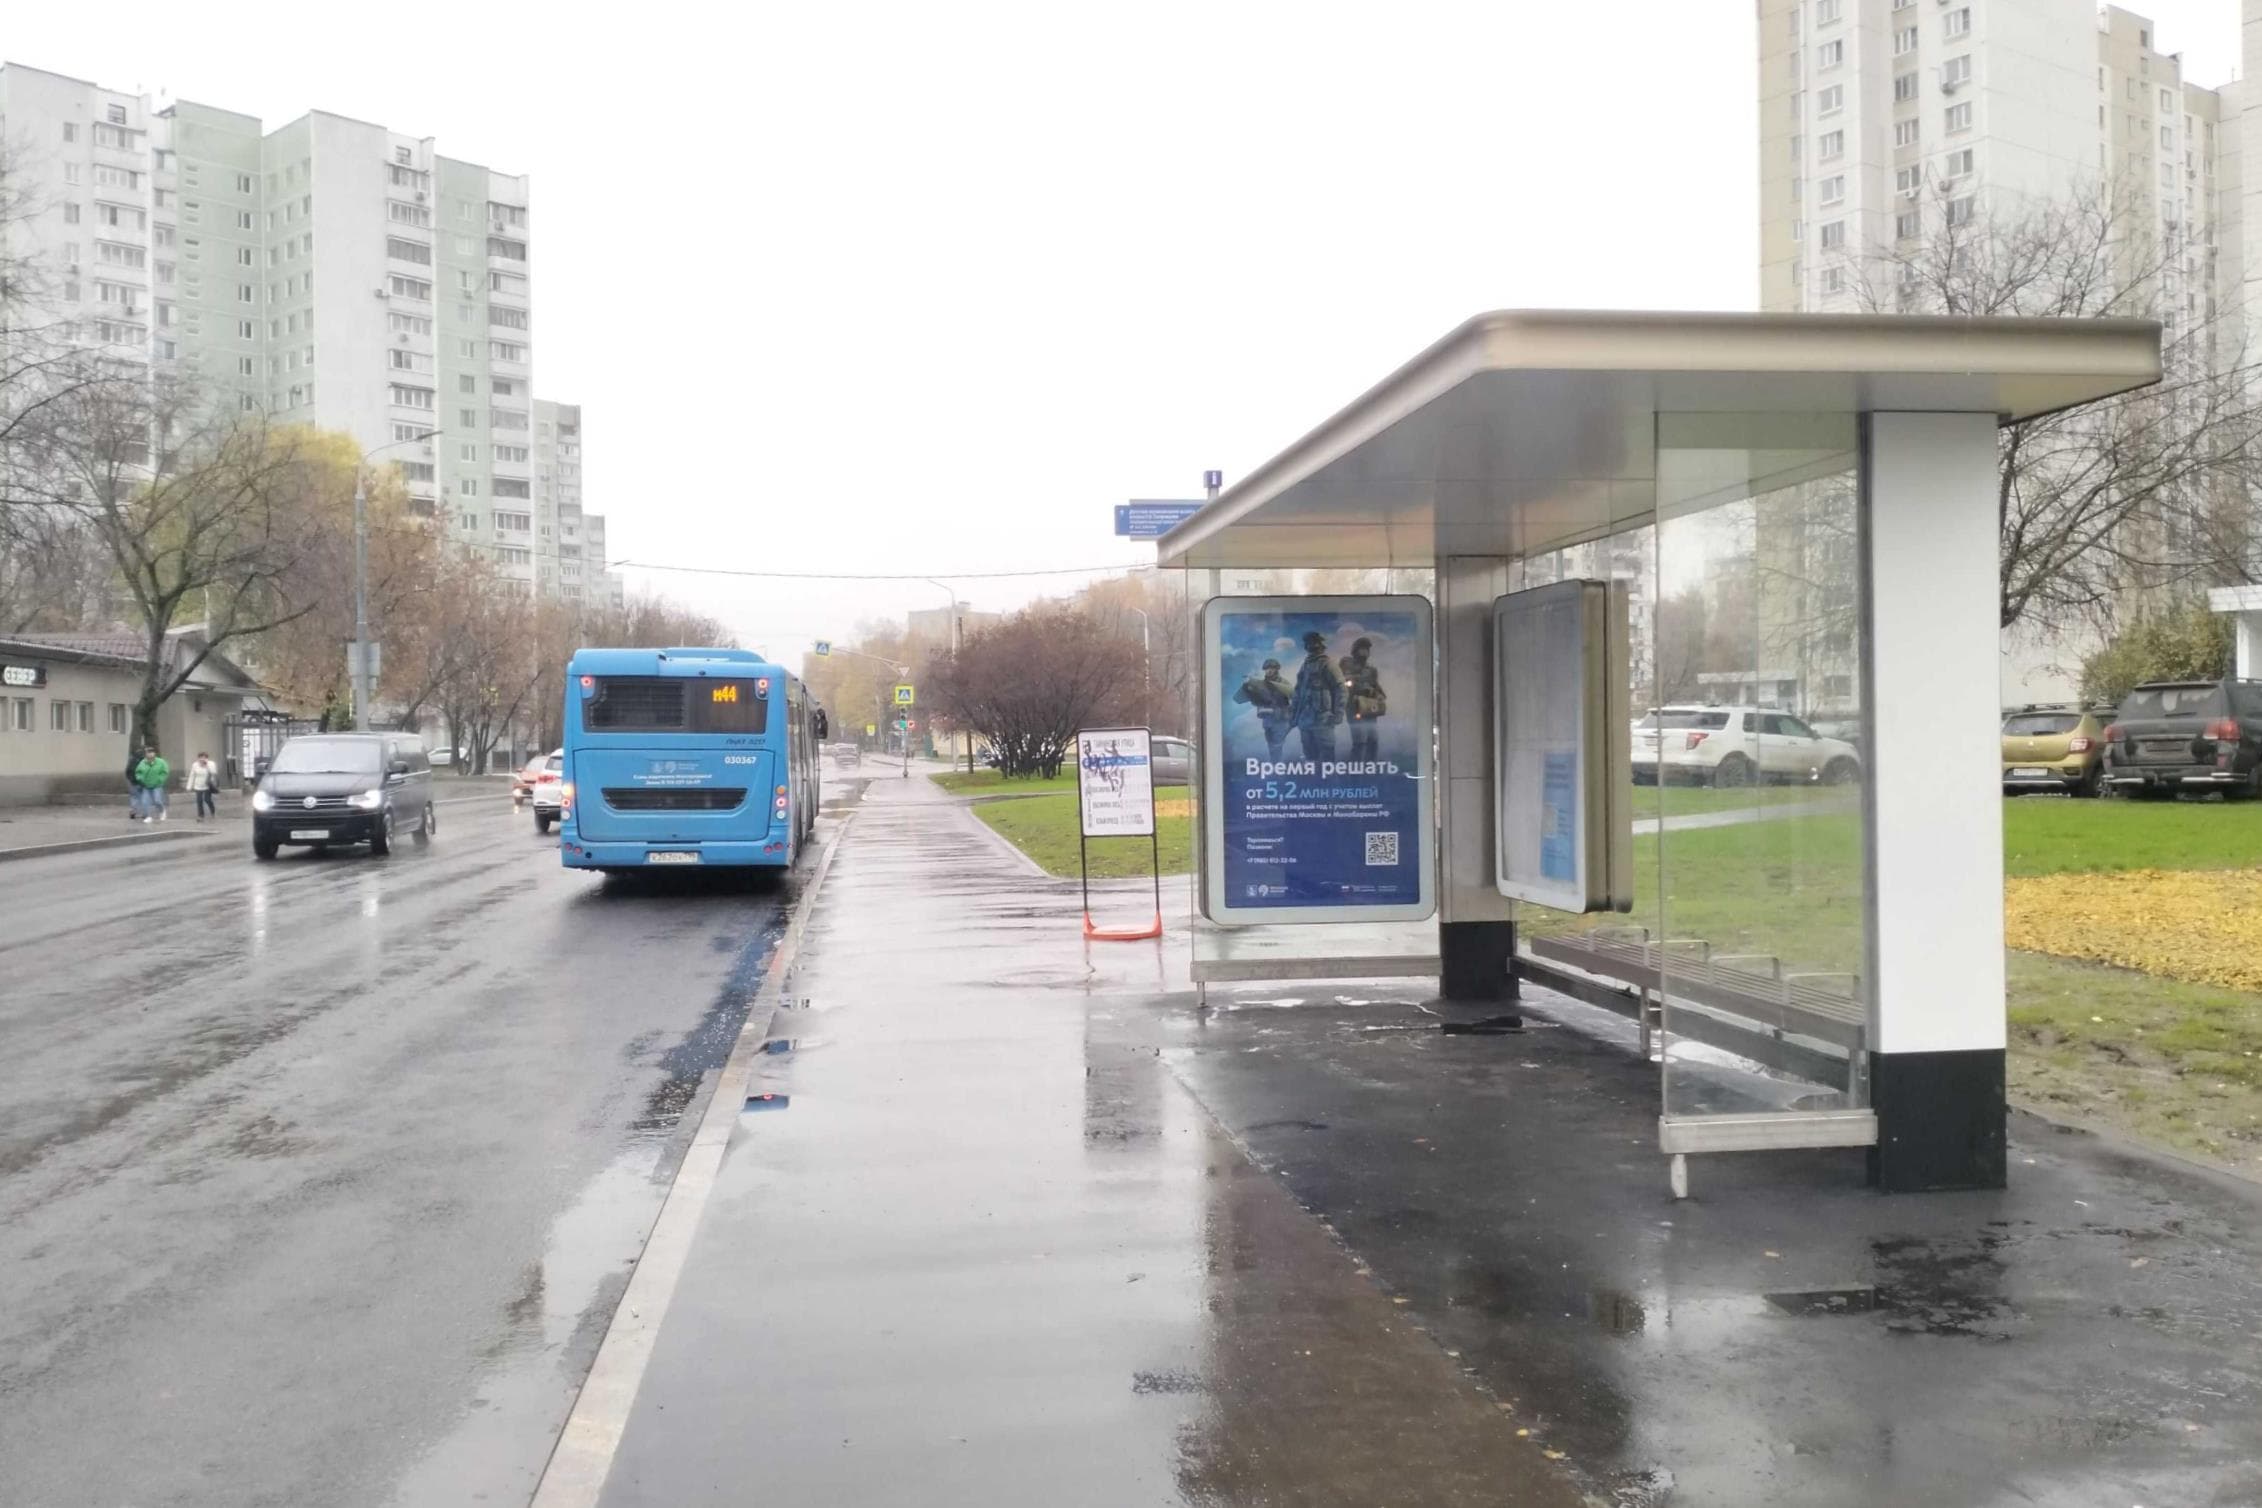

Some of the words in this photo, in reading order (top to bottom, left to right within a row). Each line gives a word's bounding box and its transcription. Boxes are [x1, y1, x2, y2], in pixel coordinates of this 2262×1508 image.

[1246, 758, 1315, 779] Время
[1321, 760, 1398, 779] решать
[1246, 788, 1263, 799] от
[1266, 781, 1296, 801] 5,2
[1300, 788, 1329, 799] МЛН
[1332, 786, 1378, 799] РУБЛЕЙ
[1246, 811, 1297, 820] Правительства
